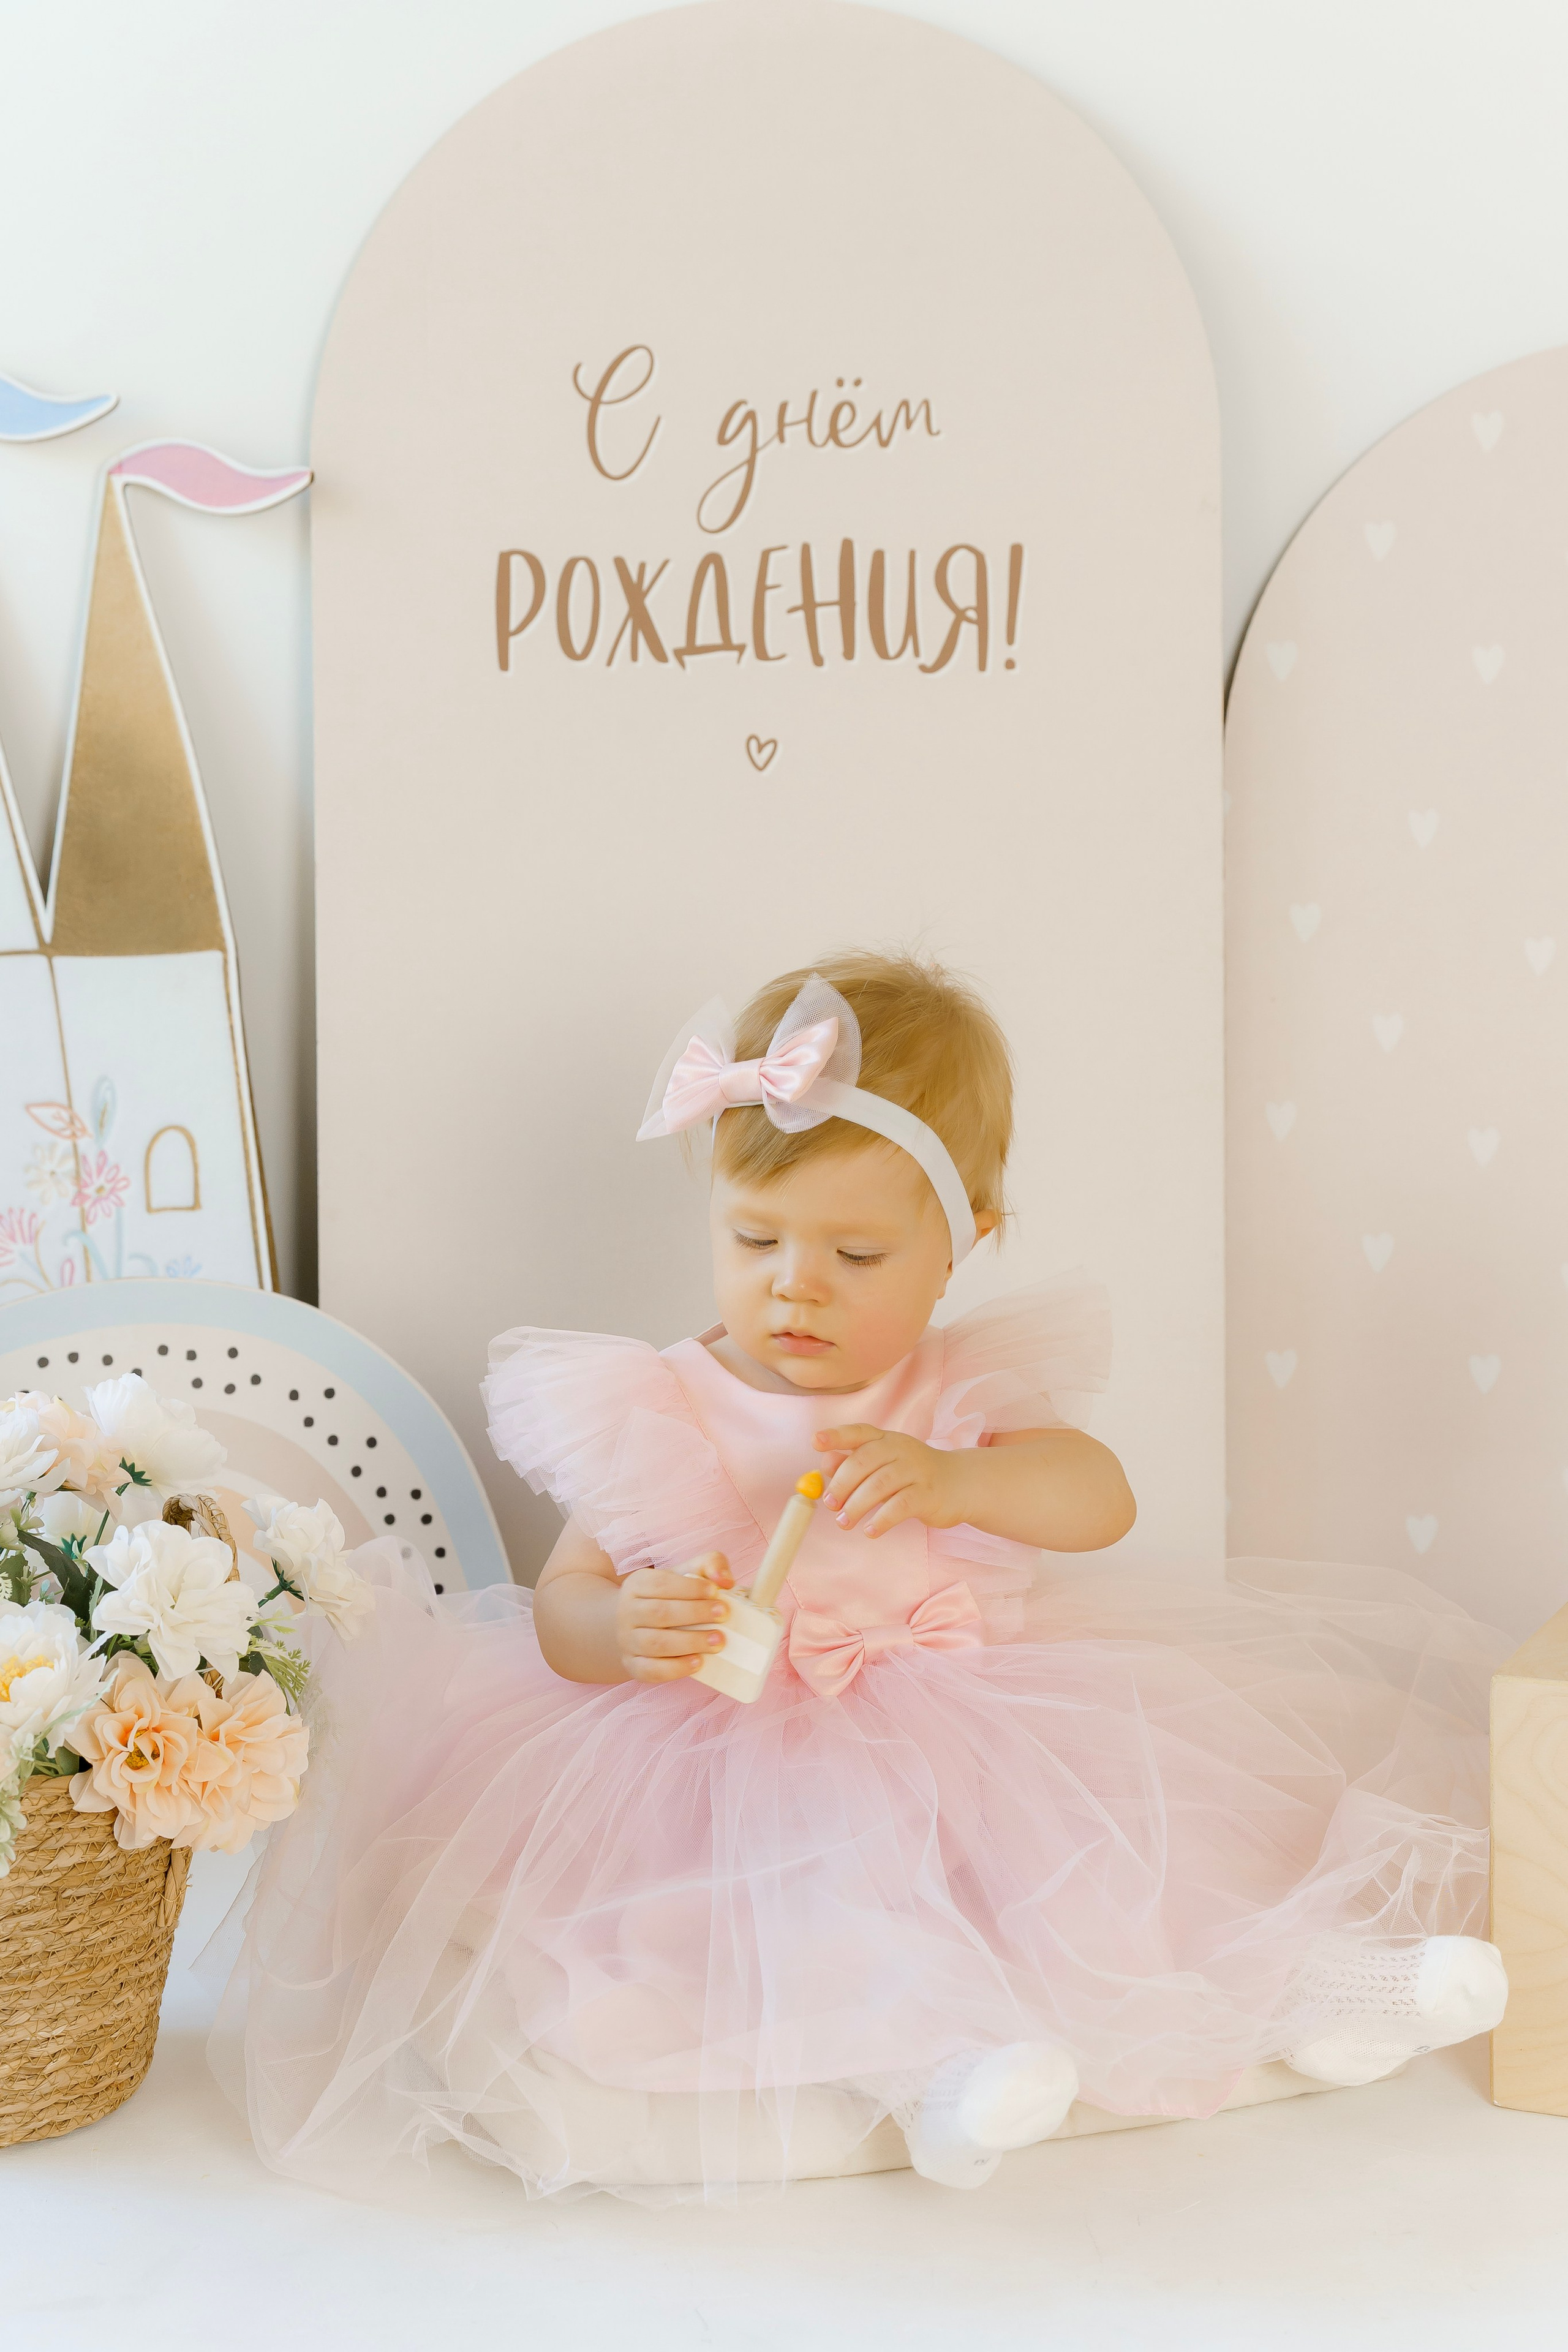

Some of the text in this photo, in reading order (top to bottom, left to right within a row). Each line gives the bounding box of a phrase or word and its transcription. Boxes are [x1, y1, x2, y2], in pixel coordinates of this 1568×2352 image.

[573, 345, 941, 533] С днём
[496, 538, 1023, 674] РОЖДЕНИЯ!
